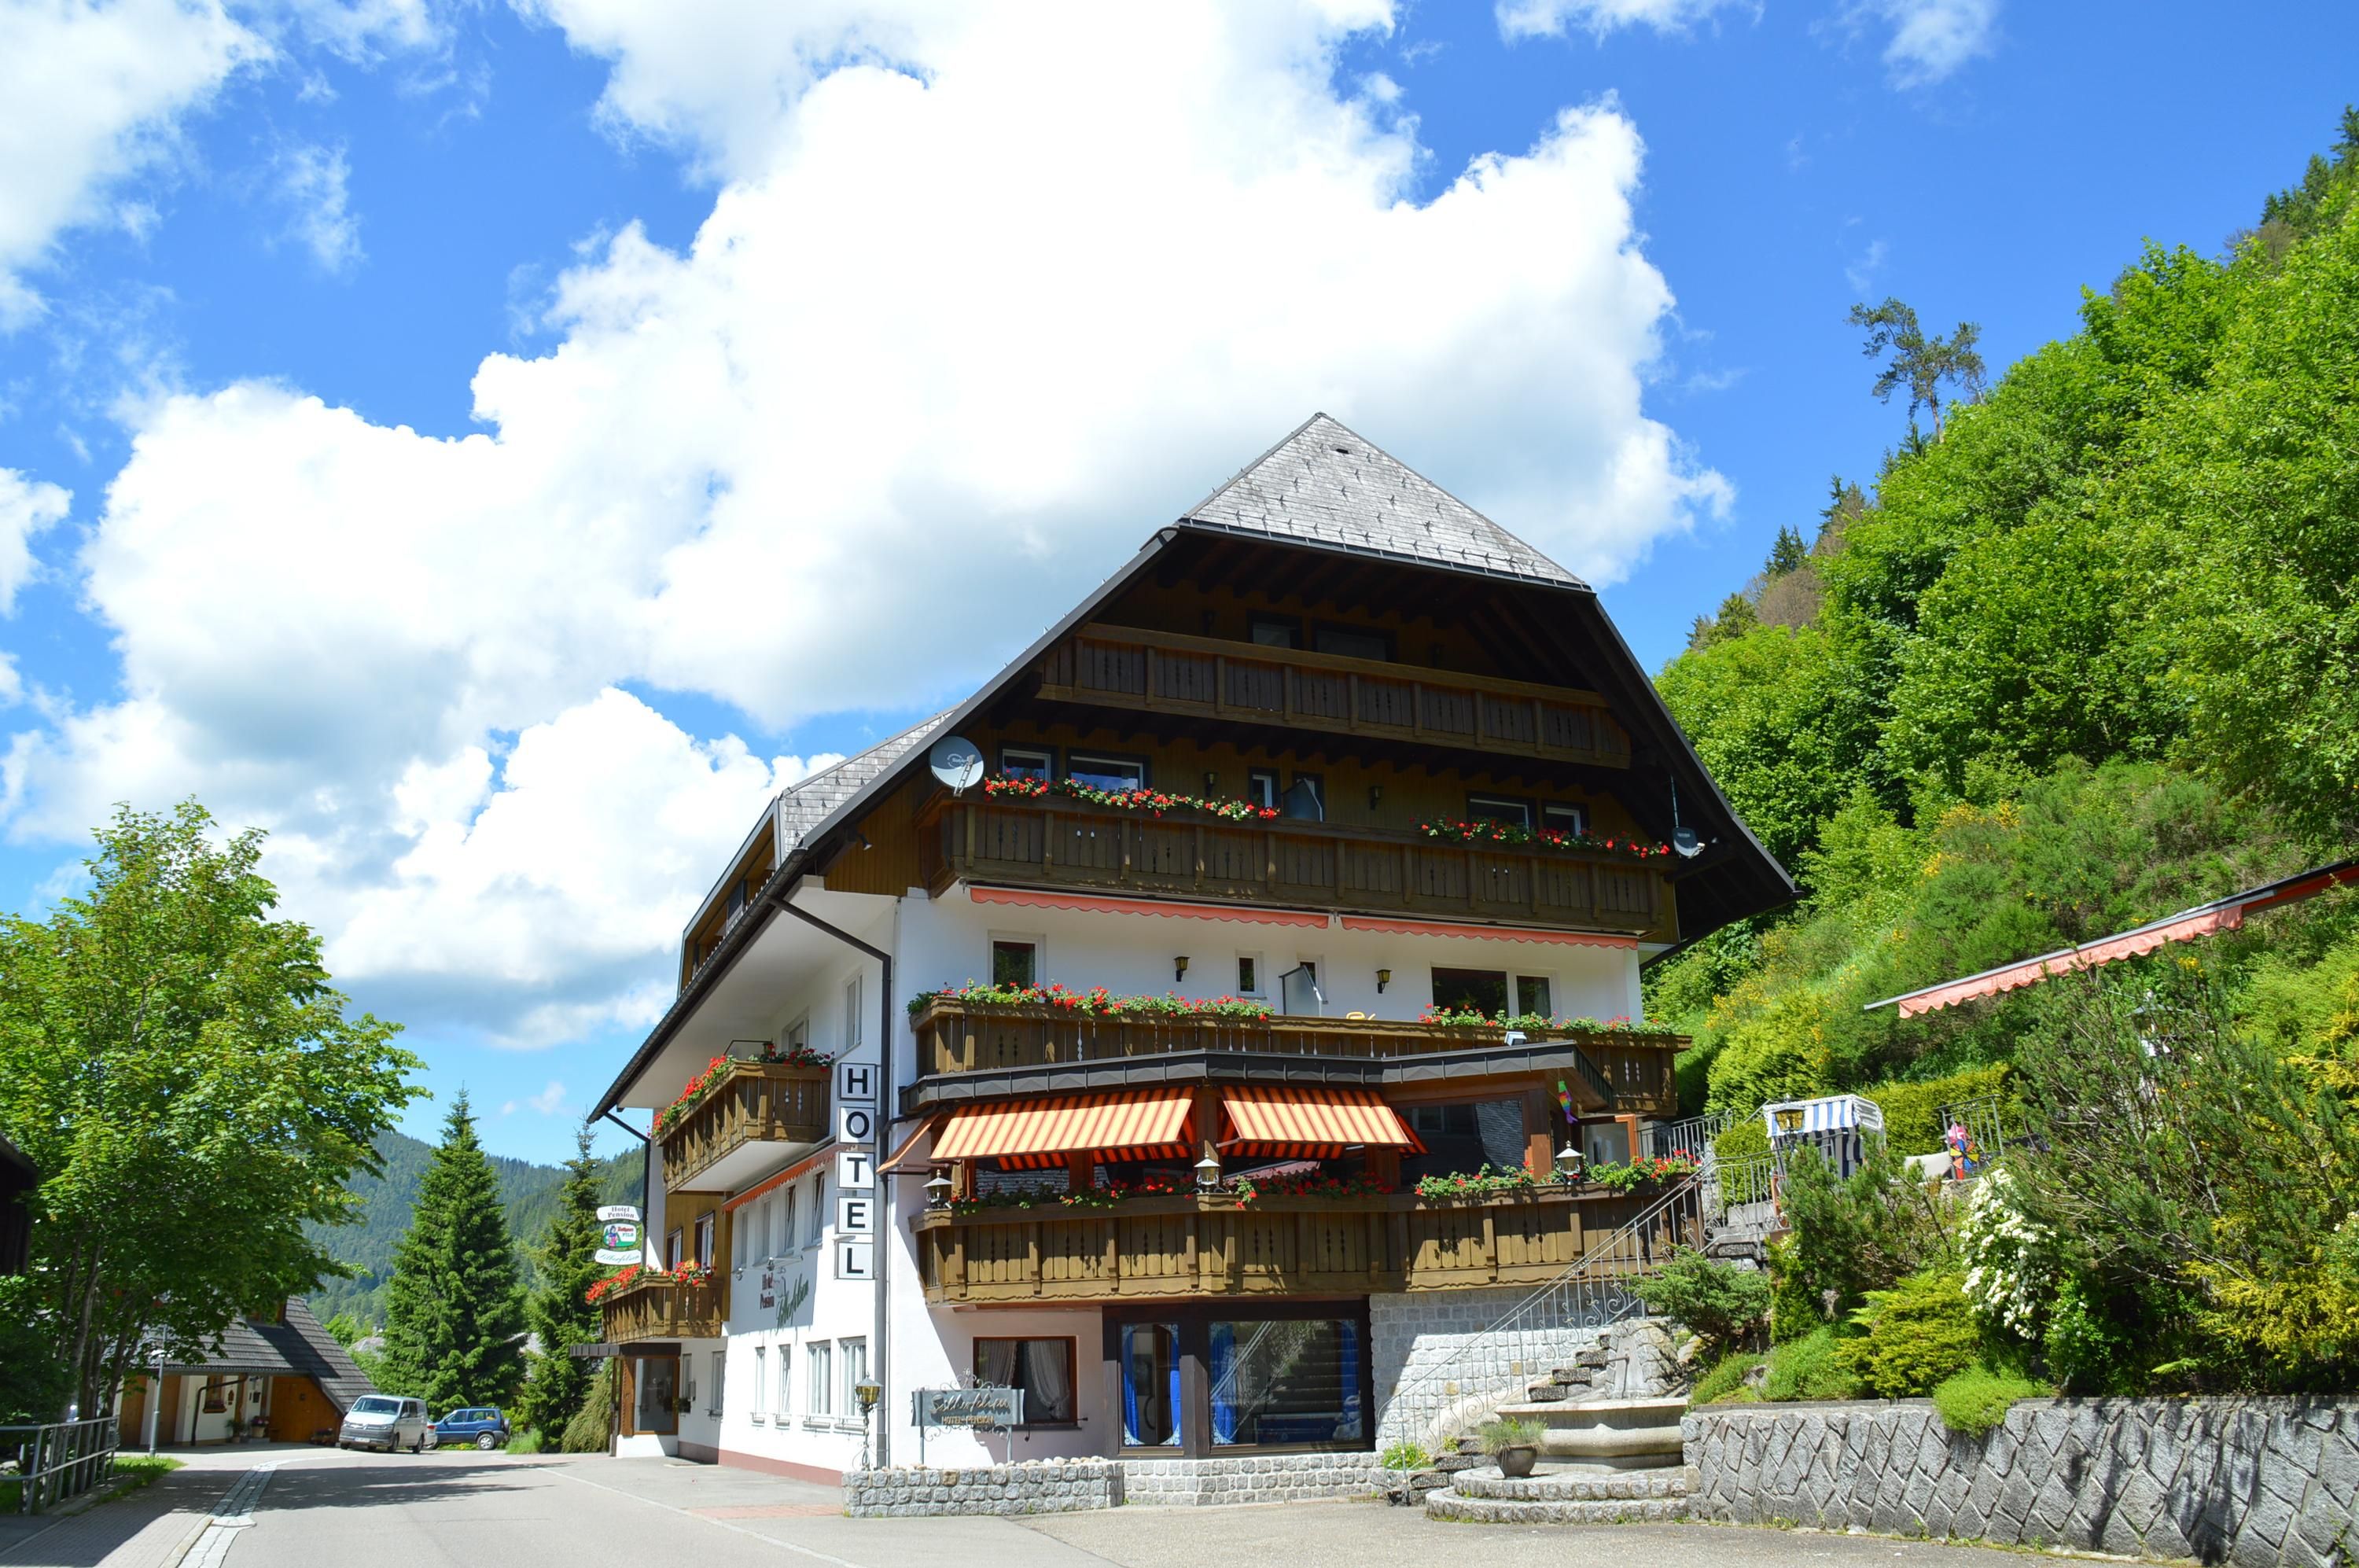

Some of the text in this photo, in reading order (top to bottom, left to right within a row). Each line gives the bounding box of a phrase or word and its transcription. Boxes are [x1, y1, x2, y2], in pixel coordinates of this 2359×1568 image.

[845, 1068, 870, 1275] HOTEL
[762, 1272, 774, 1290] Hotel
[760, 1293, 775, 1310] Pension
